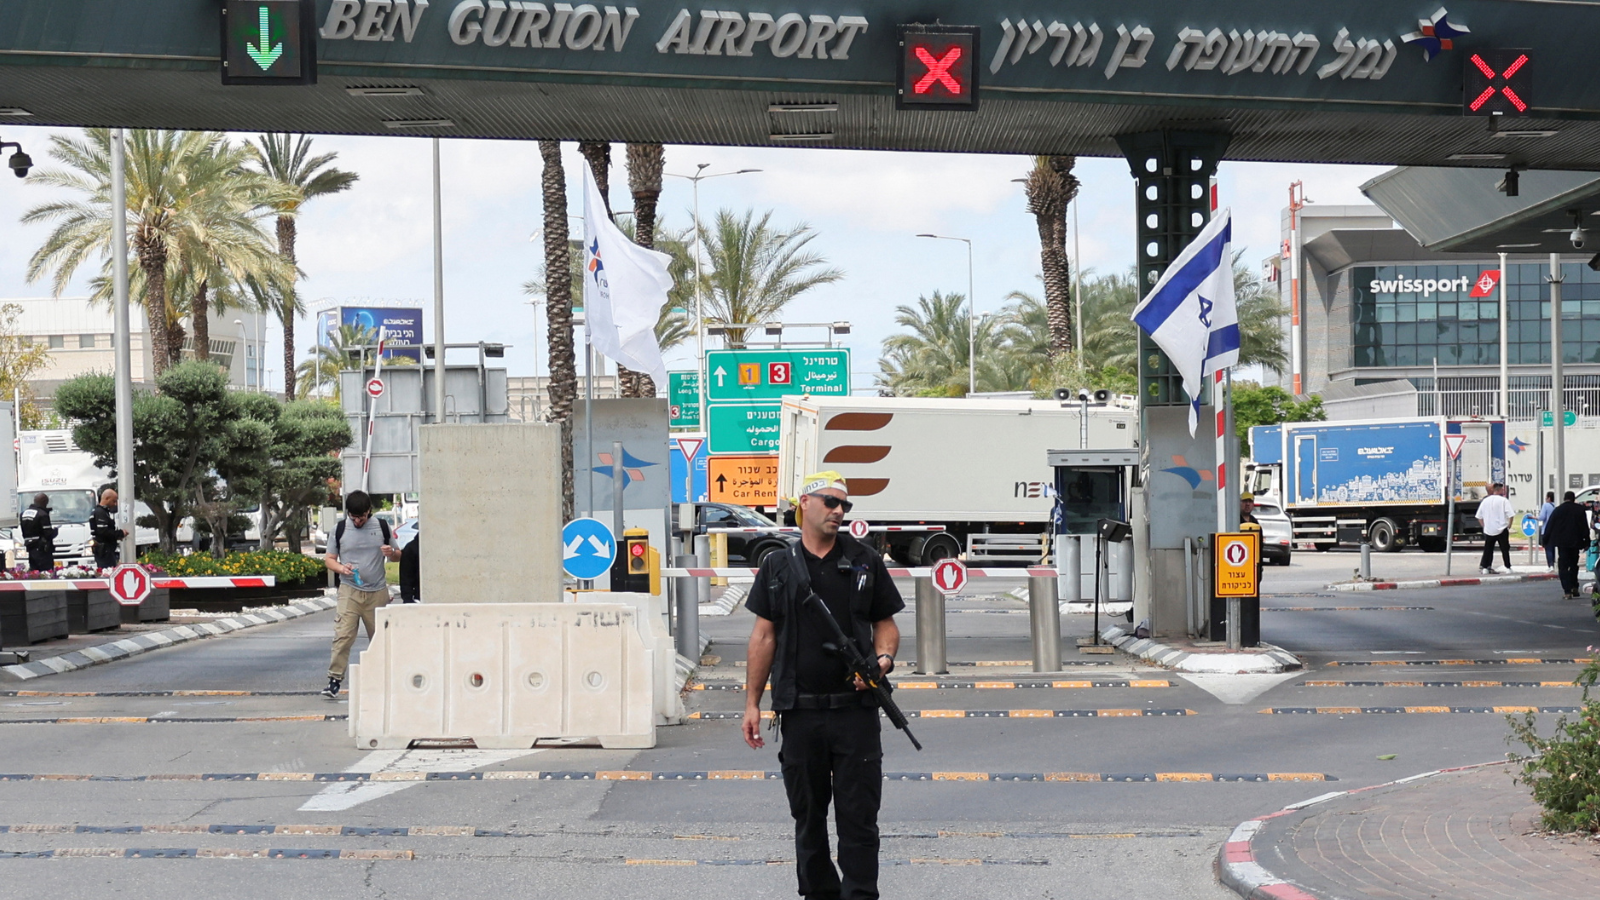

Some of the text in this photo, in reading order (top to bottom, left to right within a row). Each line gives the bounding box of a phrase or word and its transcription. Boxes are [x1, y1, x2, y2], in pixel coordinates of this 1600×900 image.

[319, 0, 869, 60] BEN GURION AIRPORT
[989, 17, 1397, 80] נמל התעופה בן גוריון
[1370, 274, 1469, 297] swissport
[802, 356, 840, 366] טרמינל
[745, 364, 787, 382] 1 3
[800, 384, 843, 393] Terminal
[672, 406, 680, 418] 3
[750, 438, 781, 448] Cargo
[738, 466, 761, 474] שכור
[733, 490, 750, 498] Car
[1228, 571, 1246, 579] עצור
